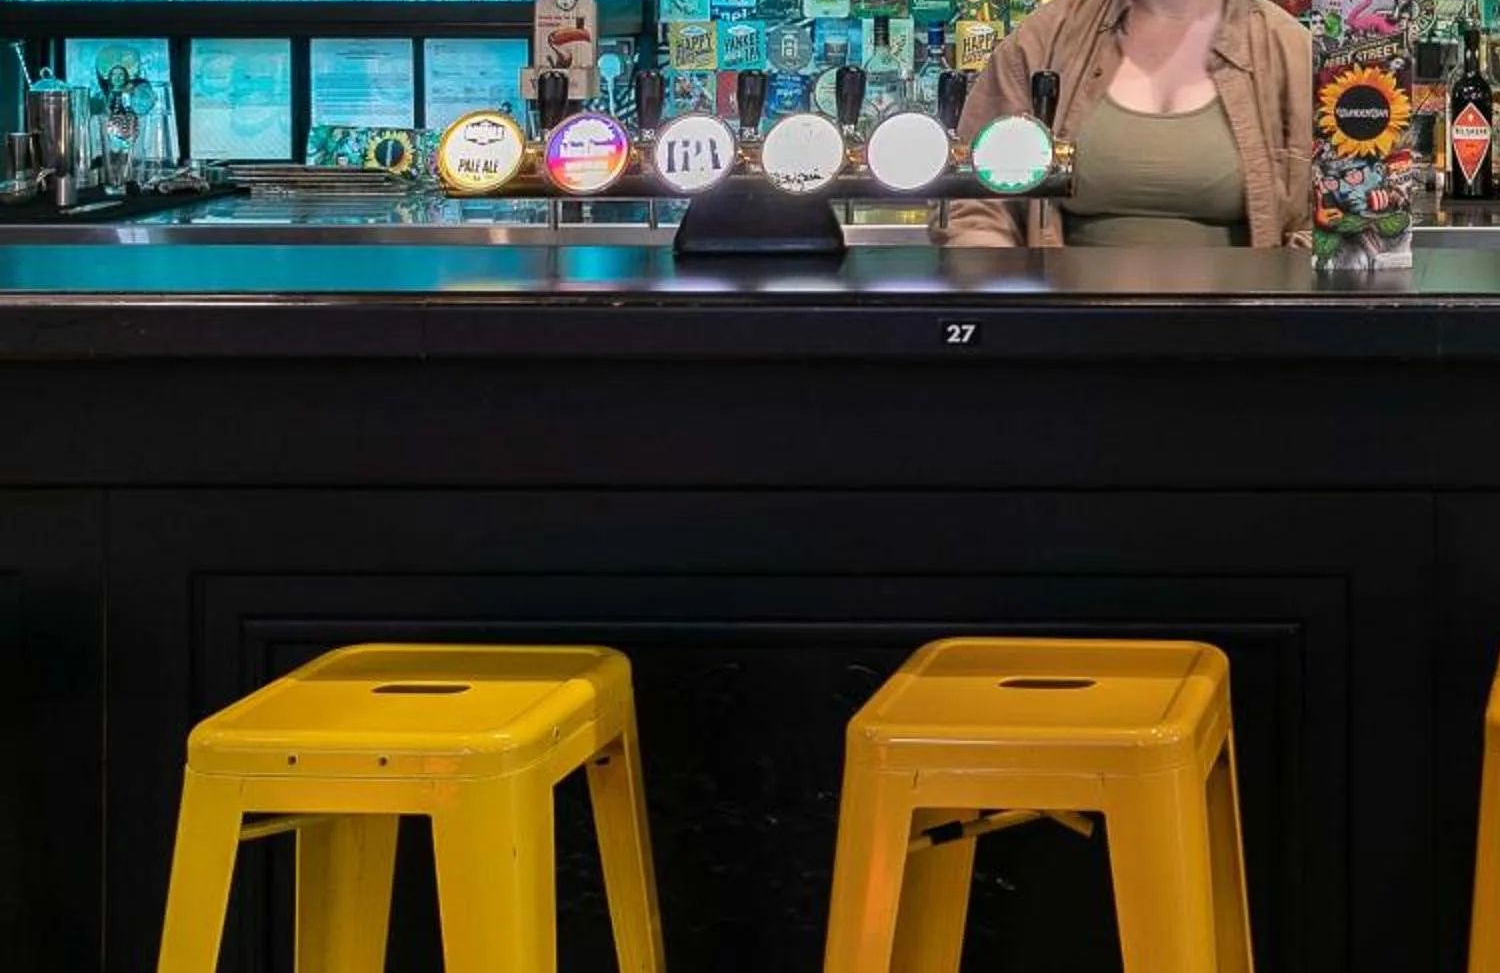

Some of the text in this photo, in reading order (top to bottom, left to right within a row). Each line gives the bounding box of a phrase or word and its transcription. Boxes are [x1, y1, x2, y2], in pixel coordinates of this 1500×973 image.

[457, 158, 499, 173] PALE ALE
[947, 324, 976, 343] 27
